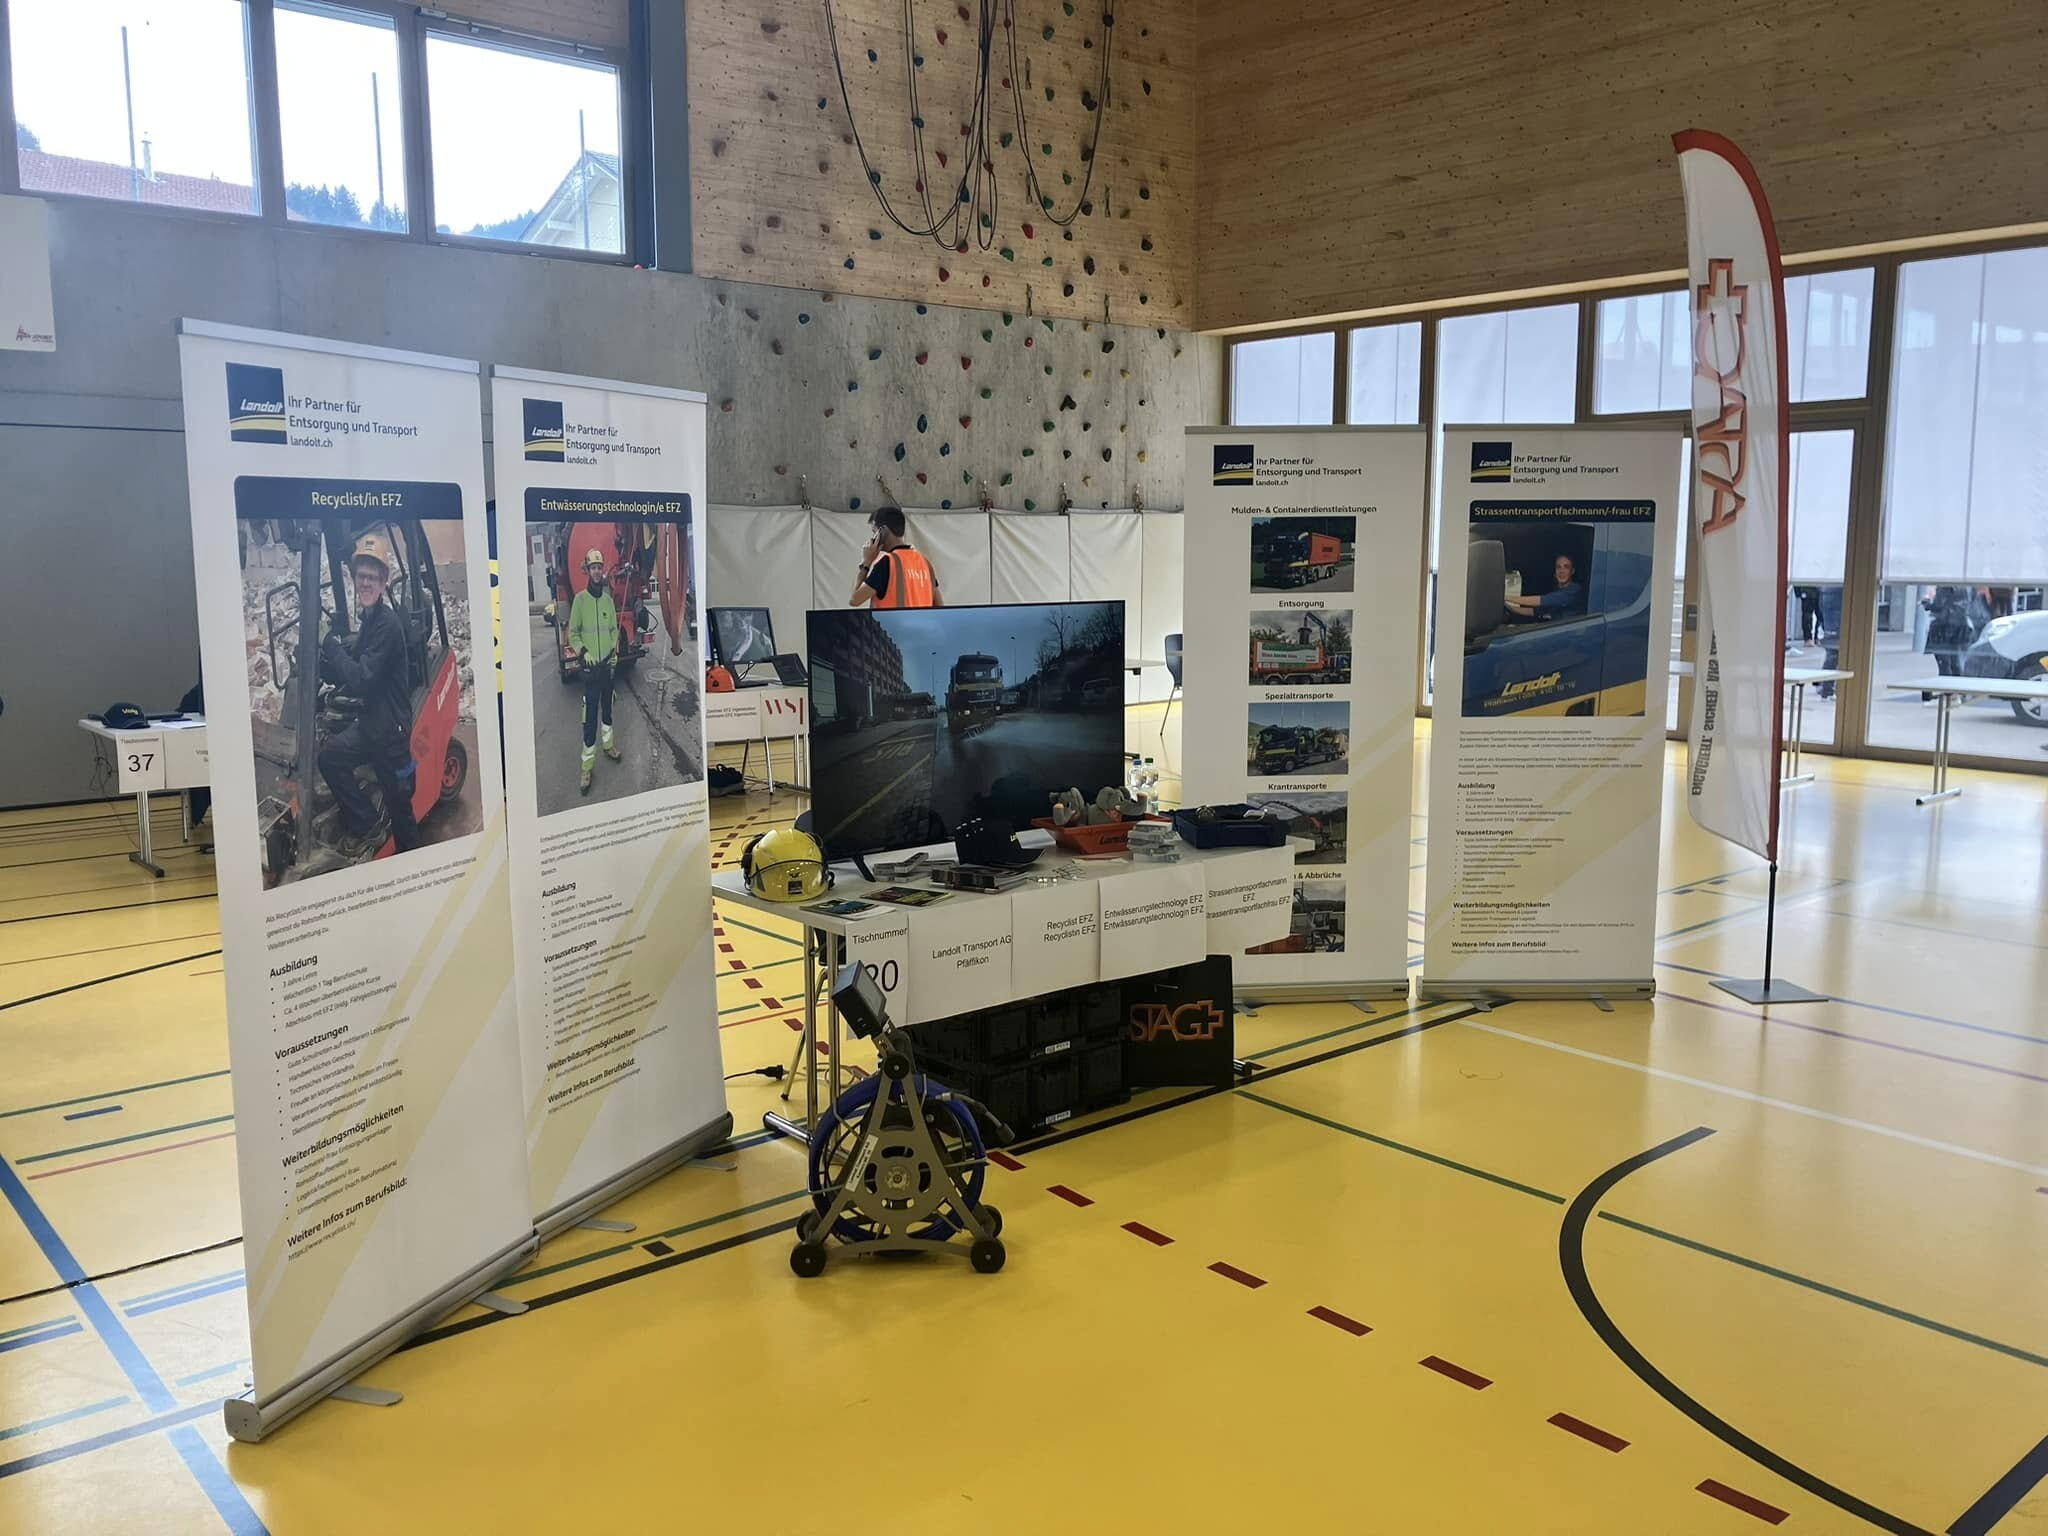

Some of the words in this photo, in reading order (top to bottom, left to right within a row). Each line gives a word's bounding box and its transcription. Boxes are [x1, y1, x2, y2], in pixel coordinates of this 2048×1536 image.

[240, 398, 284, 413] Landolt
[288, 396, 302, 408] Ihr
[305, 397, 343, 412] Partner
[346, 400, 361, 413] für
[289, 415, 349, 434] Entsorgung
[352, 419, 369, 432] und
[372, 421, 418, 438] Transport
[531, 426, 562, 438] Landolt
[565, 424, 576, 434] Ihr
[577, 424, 607, 437] Partner
[608, 426, 618, 437] für
[291, 436, 333, 448] landolt.ch
[566, 440, 610, 454] Entsorgung
[611, 443, 625, 453] und
[626, 443, 661, 456] Transport
[567, 456, 597, 465] landolt.ch
[1269, 457, 1300, 465] Partner
[1302, 457, 1314, 465] für
[1527, 455, 1558, 464] Partner
[1559, 455, 1571, 463] für
[1256, 468, 1303, 477] Entsorgung
[1322, 467, 1362, 476] Transport
[1514, 466, 1560, 475] Entsorgung
[1580, 466, 1619, 475] Transport
[311, 491, 379, 510] Recyclist/in
[381, 493, 403, 506] EFZ
[540, 498, 664, 515] Entwässerungstechnologin/e
[666, 501, 681, 513] EFZ
[1231, 506, 1264, 514] Mulden-
[1265, 506, 1271, 514] &
[1272, 505, 1377, 515] Containerdienstleistungen
[1474, 506, 1631, 517] Strassentransportfachmann/-frau
[1633, 507, 1651, 515] EFZ
[1279, 600, 1325, 608] Entsorgung
[1501, 671, 1561, 697] Landolt
[1265, 692, 1334, 701] Spezialtransporte
[128, 753, 154, 772] 37
[1268, 783, 1328, 791] Krantransporte
[1457, 782, 1495, 790] Ausbildung
[1298, 872, 1304, 880] &
[1305, 872, 1342, 880] Abbrüche
[542, 882, 576, 898] Ausbildung
[1208, 877, 1287, 898] Strassentransportfachmann
[1243, 892, 1255, 903] EFZ
[1453, 901, 1550, 909] Weiterbildungsmöglichkeiten
[1105, 897, 1188, 920] Entwässerungstechnologe
[1189, 894, 1203, 905] EFZ
[1206, 899, 1278, 919] trassentransportfachfrau
[1279, 896, 1291, 905] EFZ
[1047, 916, 1077, 931] Recyclist
[1078, 913, 1094, 924] EFZ
[1104, 908, 1190, 931] Entwässerungstechnologin
[1191, 905, 1204, 916] EFZ
[852, 927, 908, 945] Tischnummer
[1044, 926, 1080, 943] Recyclistin
[1081, 924, 1097, 936] EFZ
[544, 939, 597, 963] Voraussetzungen
[932, 944, 961, 959] Landolt
[962, 938, 999, 956] Transport
[1000, 934, 1012, 945] AG
[269, 954, 318, 978] Ausbildung
[957, 954, 989, 969] Pfäffikon
[274, 1024, 349, 1060] Voraussetzungen
[546, 1027, 636, 1072] Weiterbildungsmöglichkeiten
[547, 1086, 572, 1104] Weitere
[573, 1079, 589, 1092] Infos
[589, 1072, 603, 1085] zum
[282, 1103, 405, 1167] Weiterbildungsmöglichkeiten
[287, 1222, 321, 1247] Weitere
[322, 1210, 344, 1228] Infos
[345, 1200, 364, 1216] zum
[365, 1176, 408, 1206] Berufsbild:
